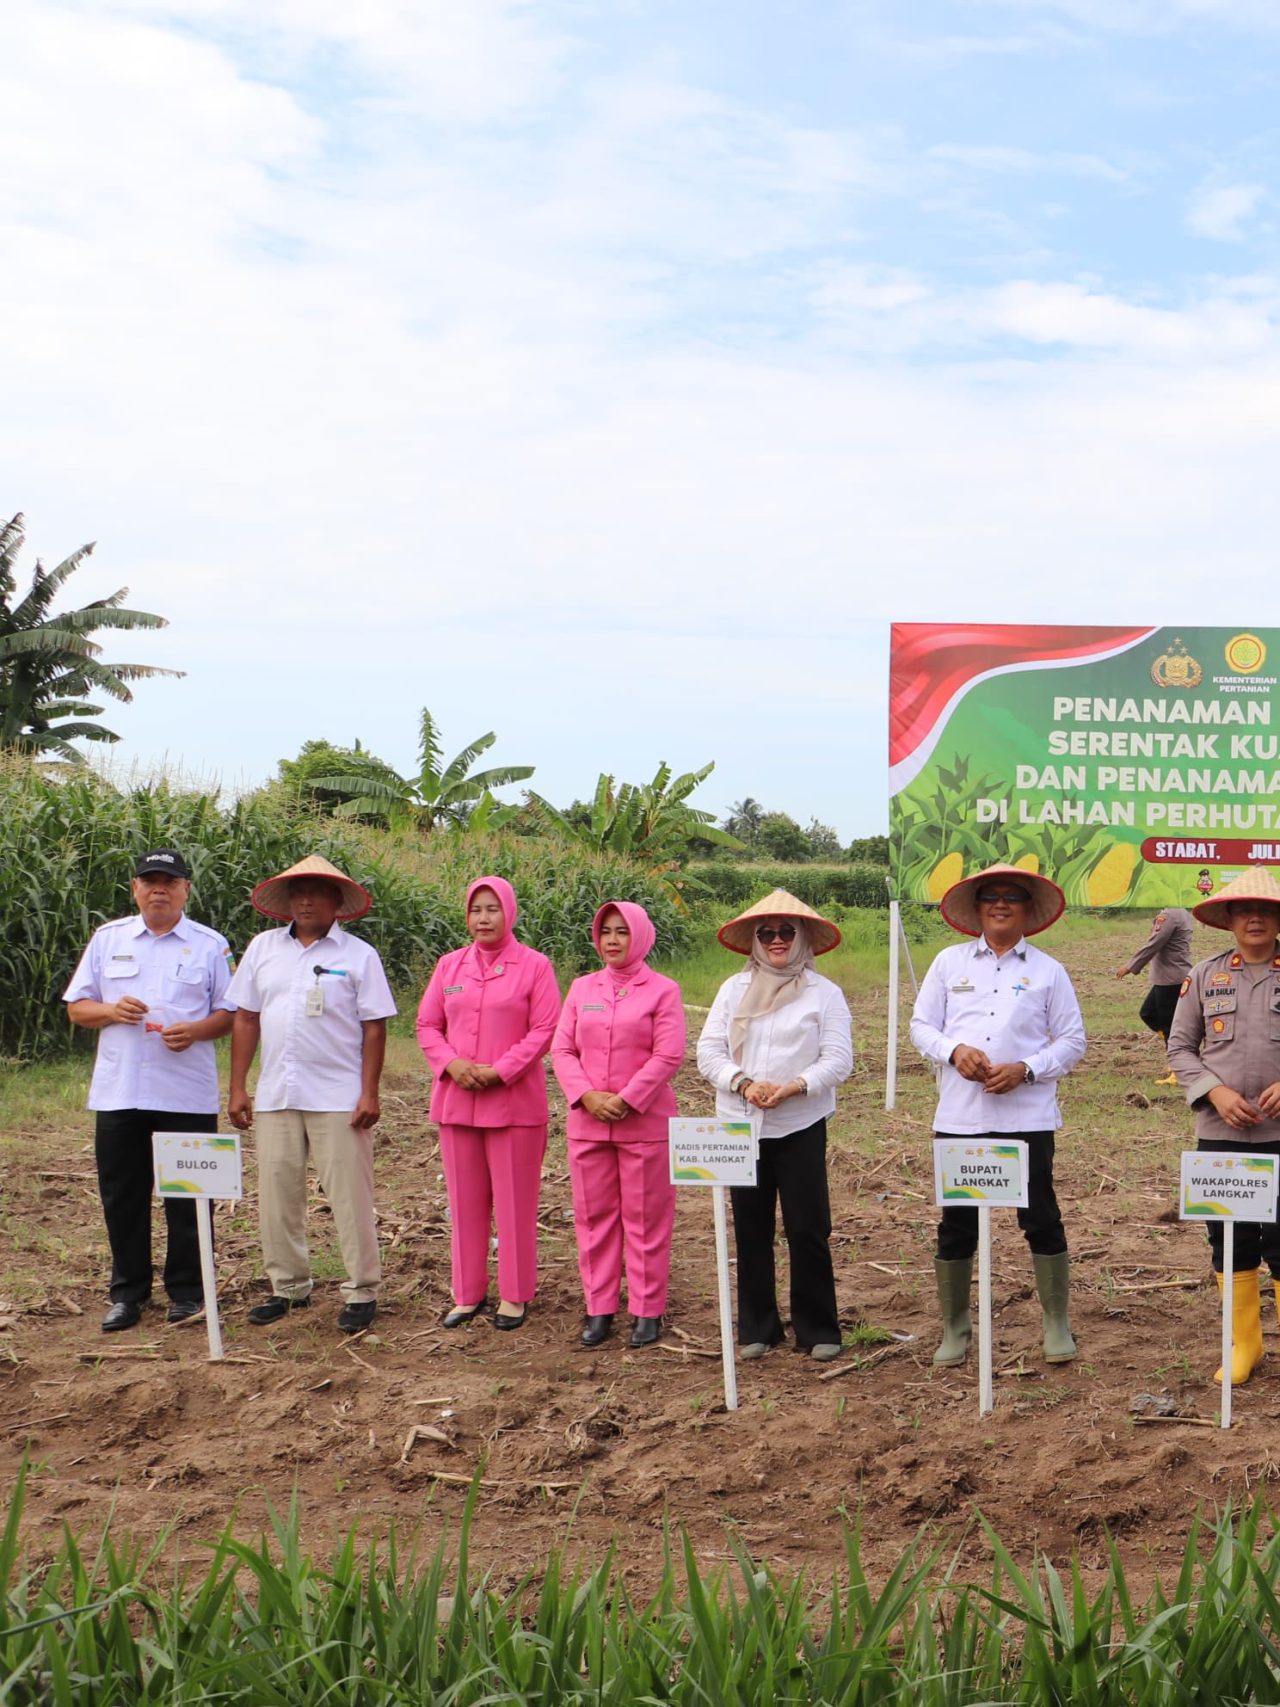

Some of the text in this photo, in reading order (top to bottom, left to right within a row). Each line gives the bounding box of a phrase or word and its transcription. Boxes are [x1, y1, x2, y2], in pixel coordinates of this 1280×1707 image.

[1212, 676, 1278, 685] KEMENTERIAN
[1219, 685, 1270, 693] PERTANIAN
[1053, 697, 1271, 725] PENANAMAN
[1048, 730, 1219, 759] SERENTAK
[1016, 765, 1086, 790] DAN
[976, 798, 1007, 823] DI
[1019, 799, 1135, 825] LAHAN
[1155, 842, 1221, 860] STABAT,
[1248, 843, 1280, 860] JULI
[675, 1143, 700, 1151] KADIS
[679, 1155, 699, 1163] KAB.
[176, 1160, 218, 1170] BULOG
[960, 1165, 1002, 1174] BUPATI
[954, 1178, 1010, 1187] LANGKAT
[1191, 1177, 1268, 1188] WAKAPOLRES
[1203, 1189, 1256, 1199] LANGKAT
